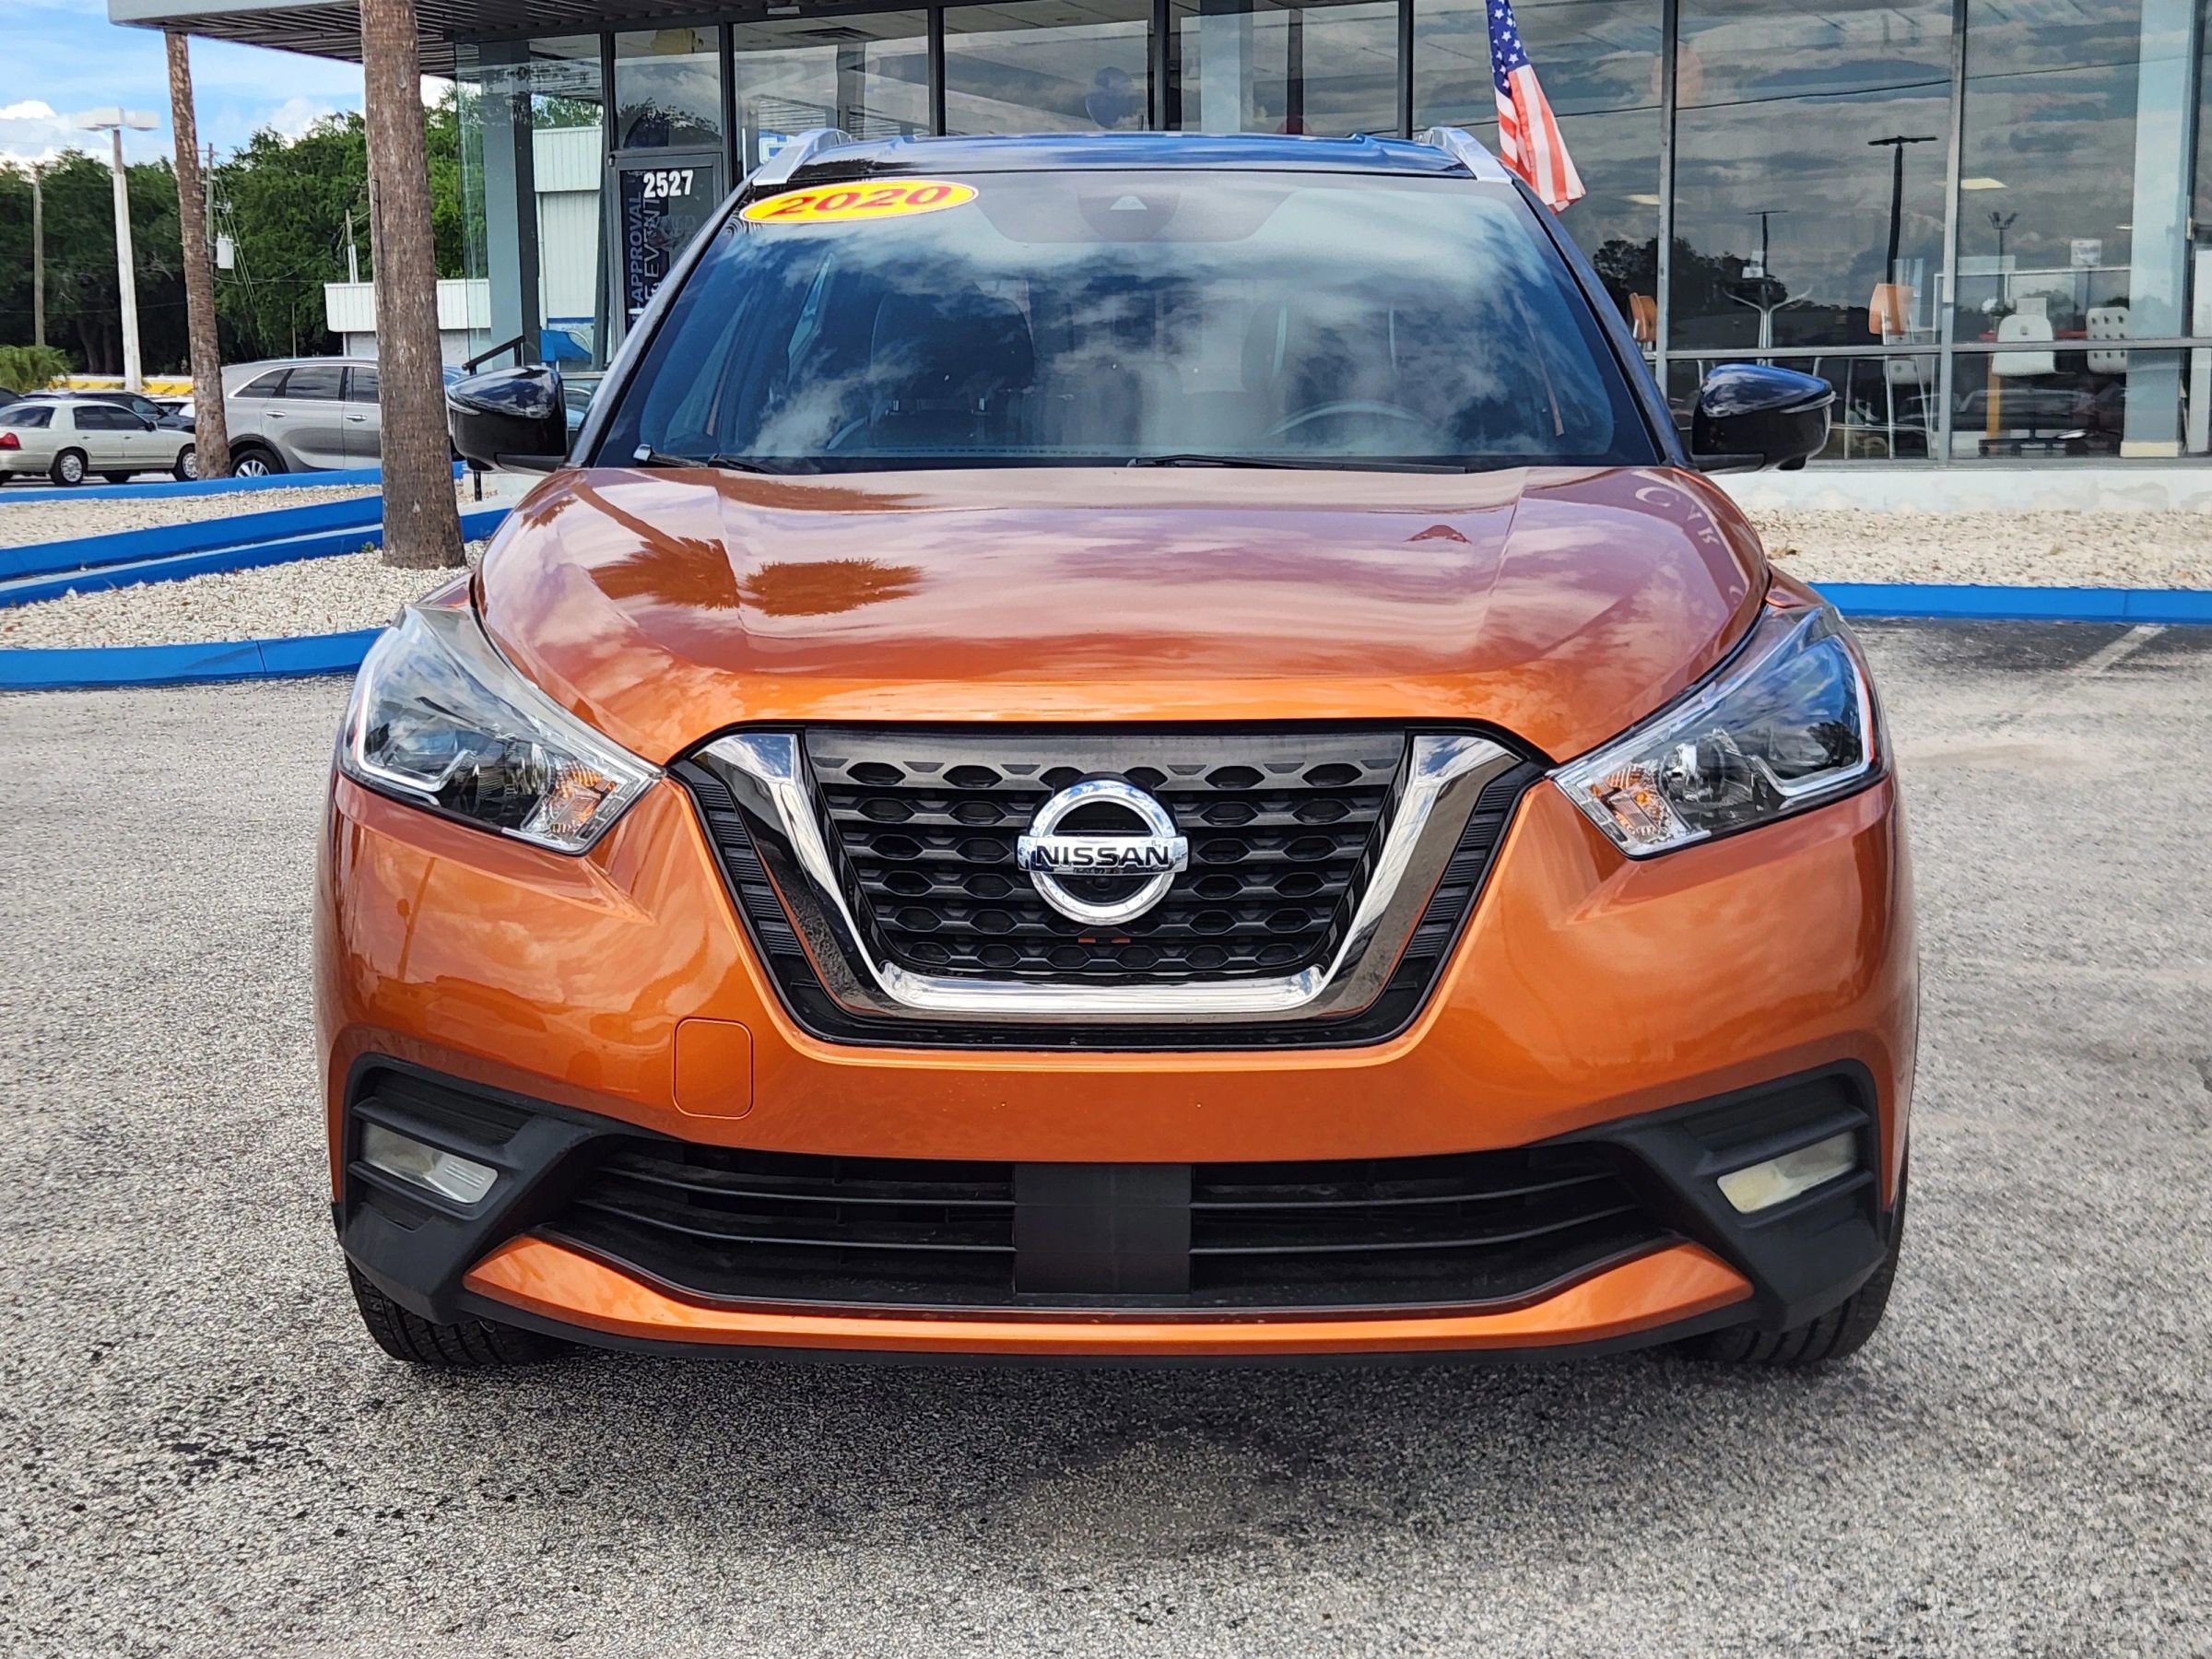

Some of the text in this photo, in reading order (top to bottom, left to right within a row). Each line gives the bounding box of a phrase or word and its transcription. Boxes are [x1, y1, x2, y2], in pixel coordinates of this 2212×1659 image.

[643, 170, 693, 198] 2527
[761, 186, 952, 219] 2020
[1036, 845, 1169, 866] NISSAN
